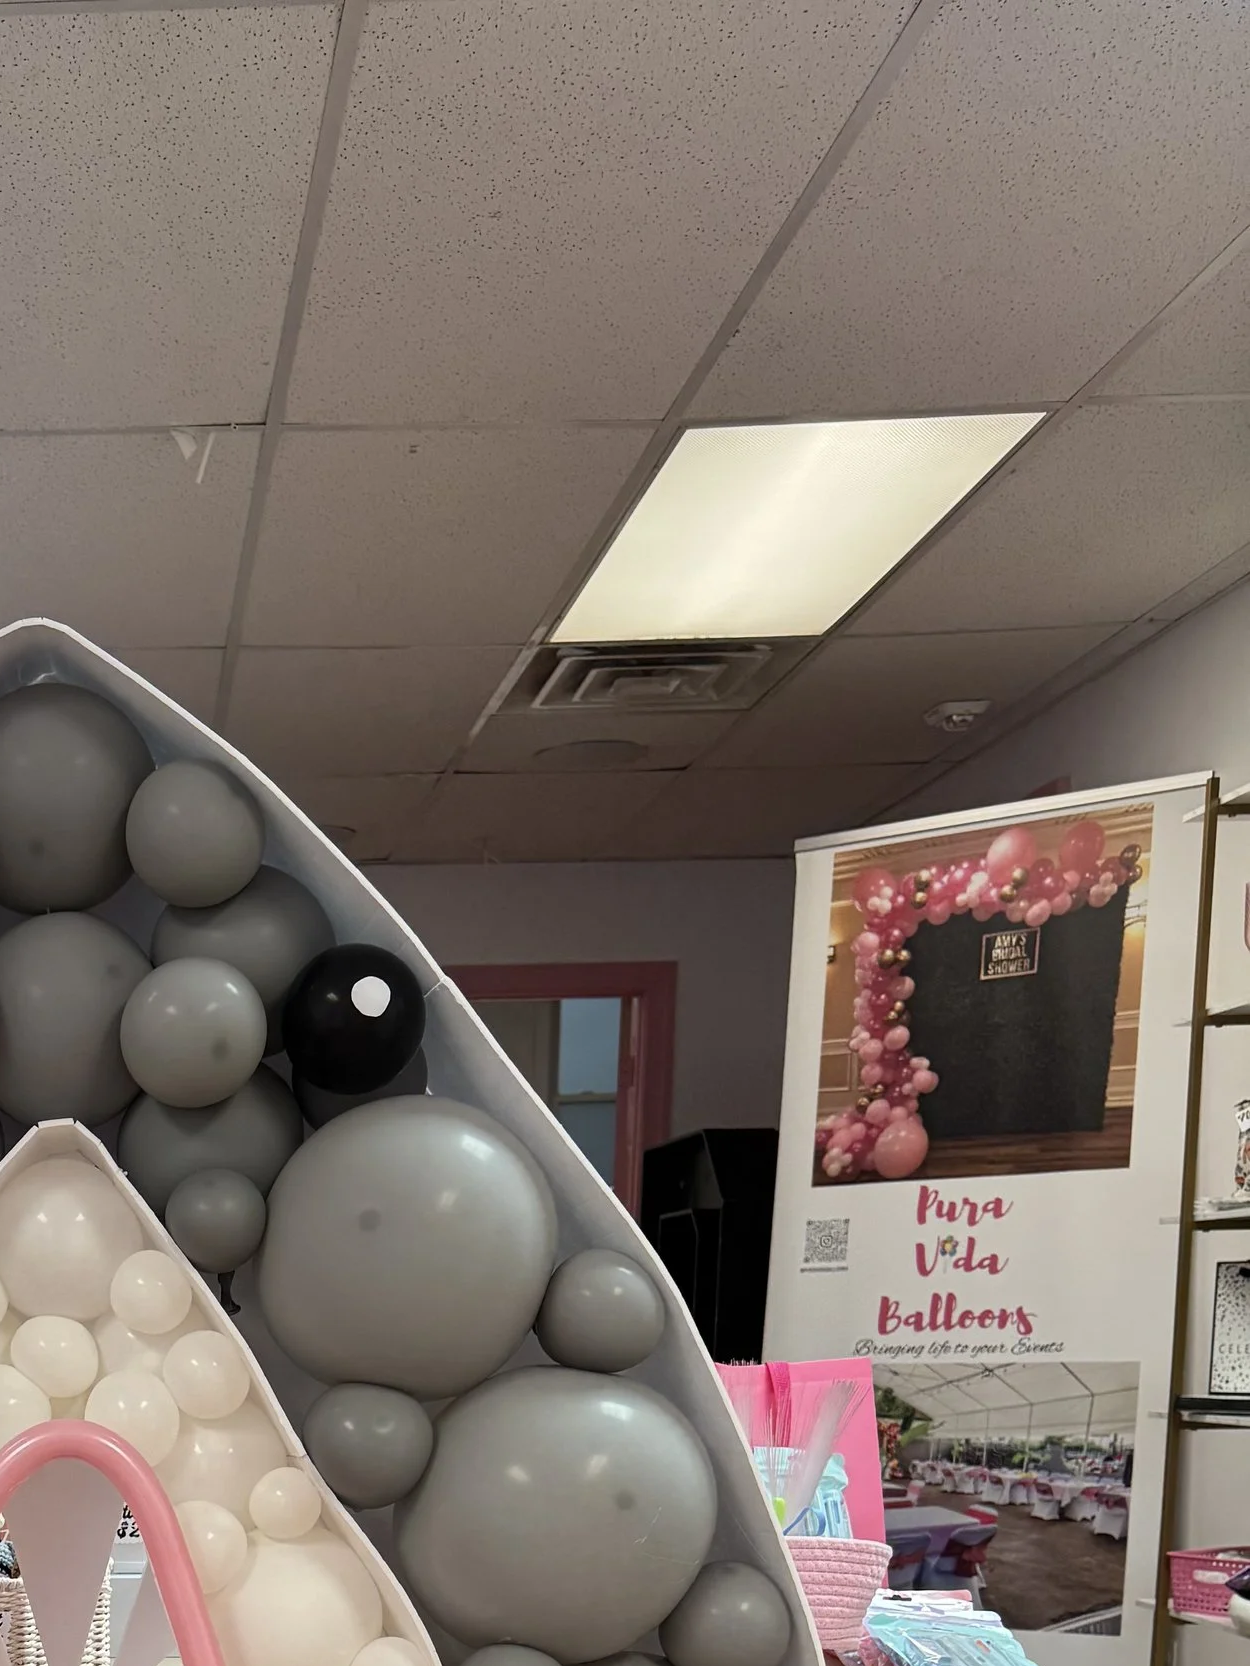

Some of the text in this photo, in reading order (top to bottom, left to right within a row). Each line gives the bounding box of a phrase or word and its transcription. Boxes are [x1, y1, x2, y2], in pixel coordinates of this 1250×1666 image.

[917, 1185, 1014, 1227] Pura
[878, 1292, 1038, 1336] Balloons
[853, 1337, 1064, 1359] Bringing life to your Events
